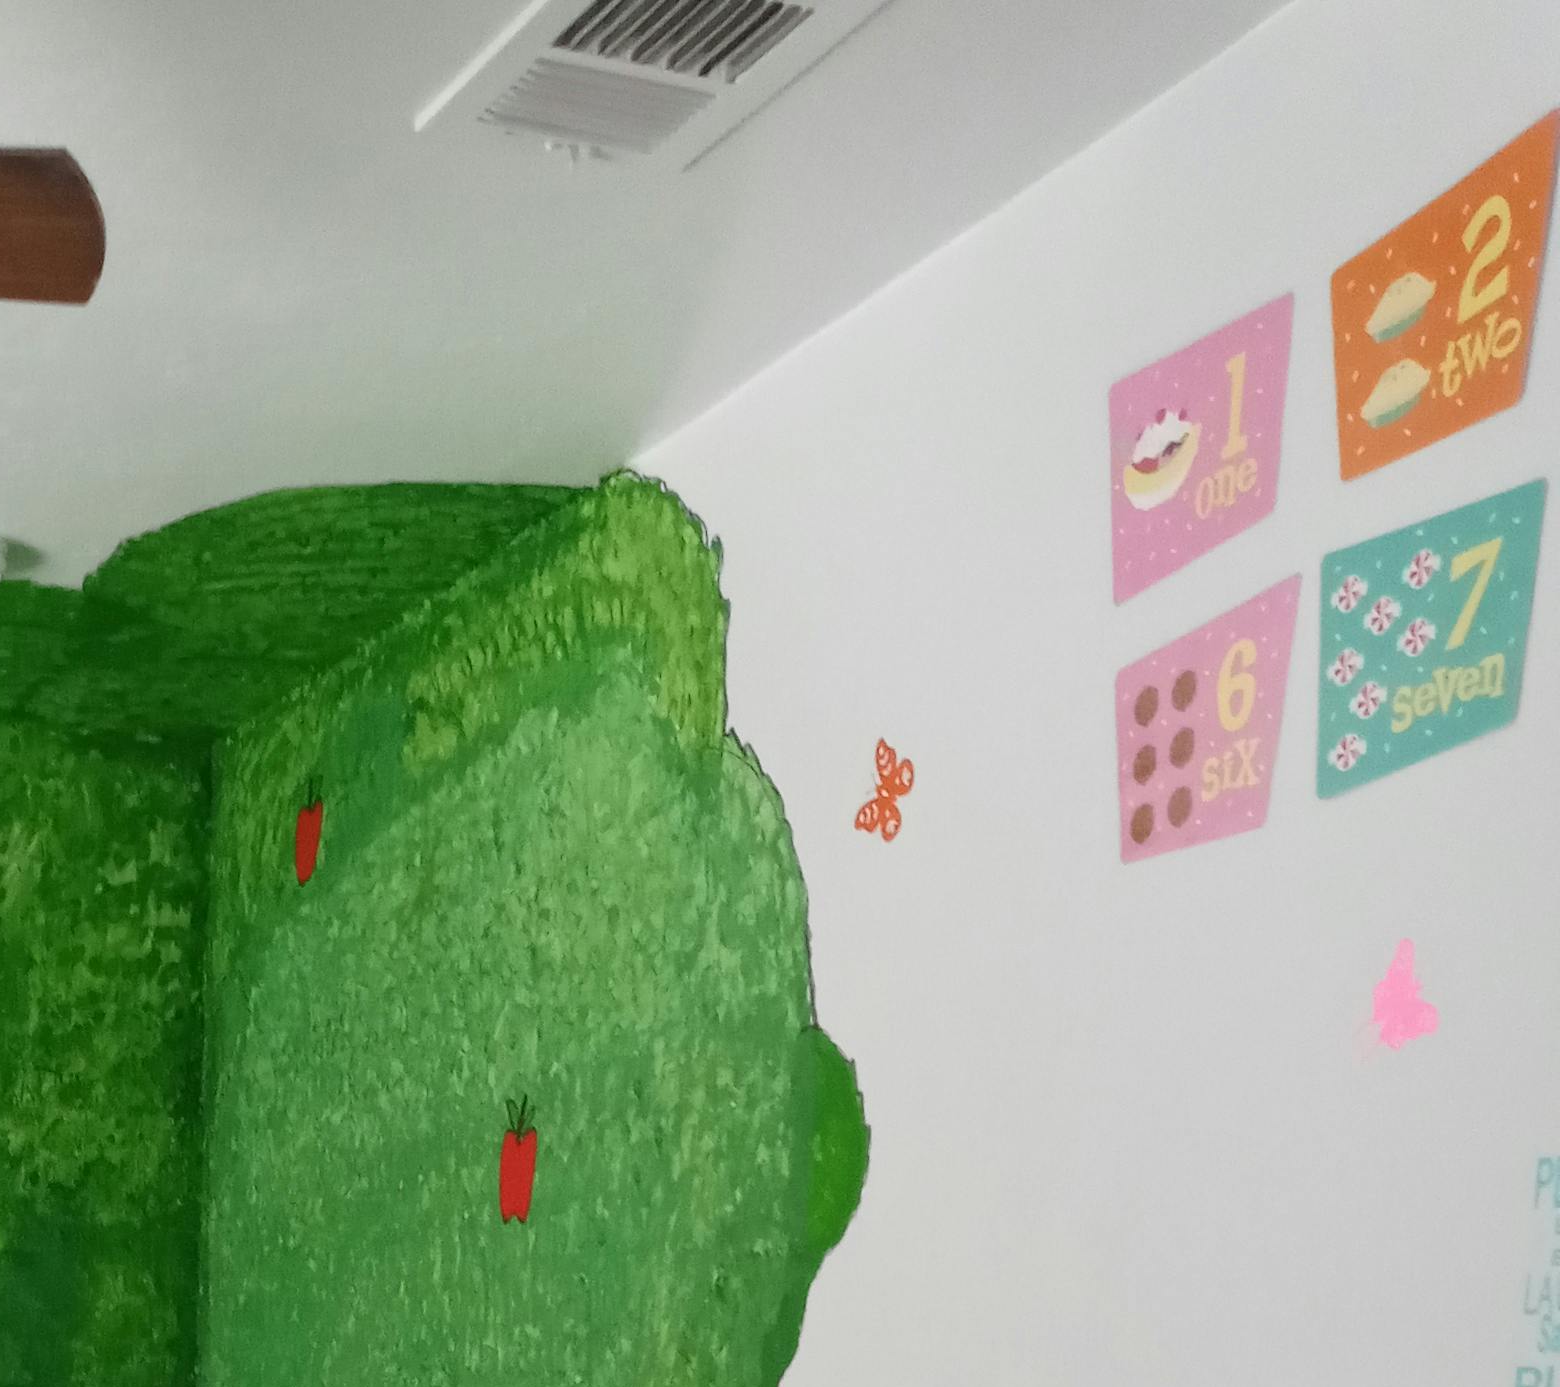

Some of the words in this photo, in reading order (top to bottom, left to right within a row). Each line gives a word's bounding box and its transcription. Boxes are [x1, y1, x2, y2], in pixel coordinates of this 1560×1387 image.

[1457, 195, 1512, 324] 2
[1220, 352, 1247, 461] 1
[1194, 456, 1258, 522] one
[1444, 536, 1503, 652] 7
[1217, 638, 1258, 732] 6
